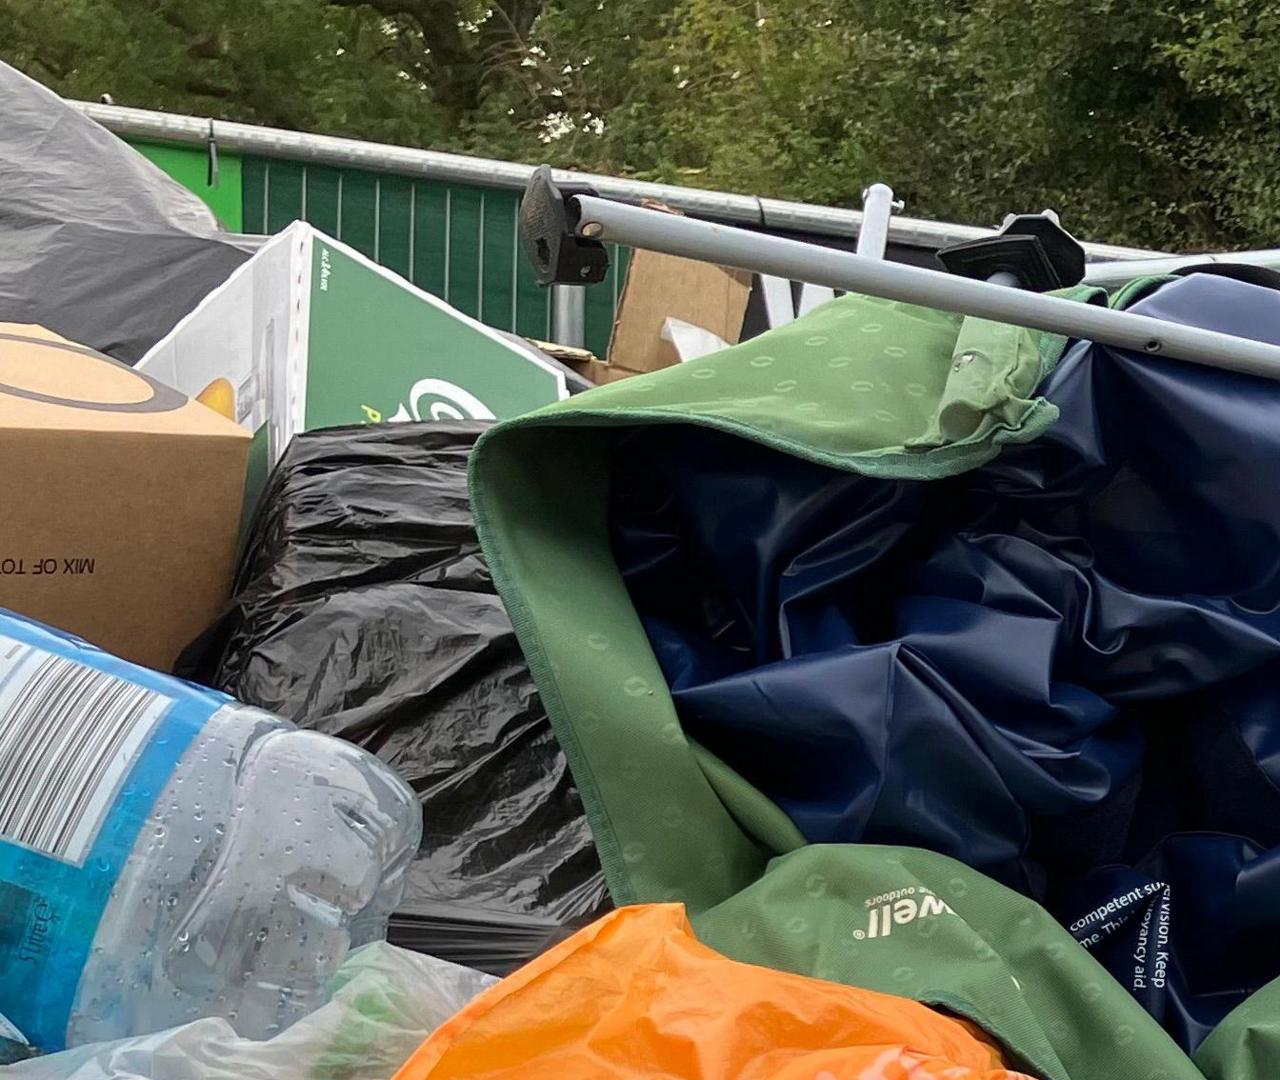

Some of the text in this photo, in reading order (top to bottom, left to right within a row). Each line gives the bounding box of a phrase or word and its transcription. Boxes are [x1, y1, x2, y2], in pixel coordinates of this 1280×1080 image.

[0, 558, 95, 575] MIX OF TO
[864, 886, 915, 908] outdoors
[1069, 876, 1165, 932] competent su
[1150, 950, 1169, 989] Keep
